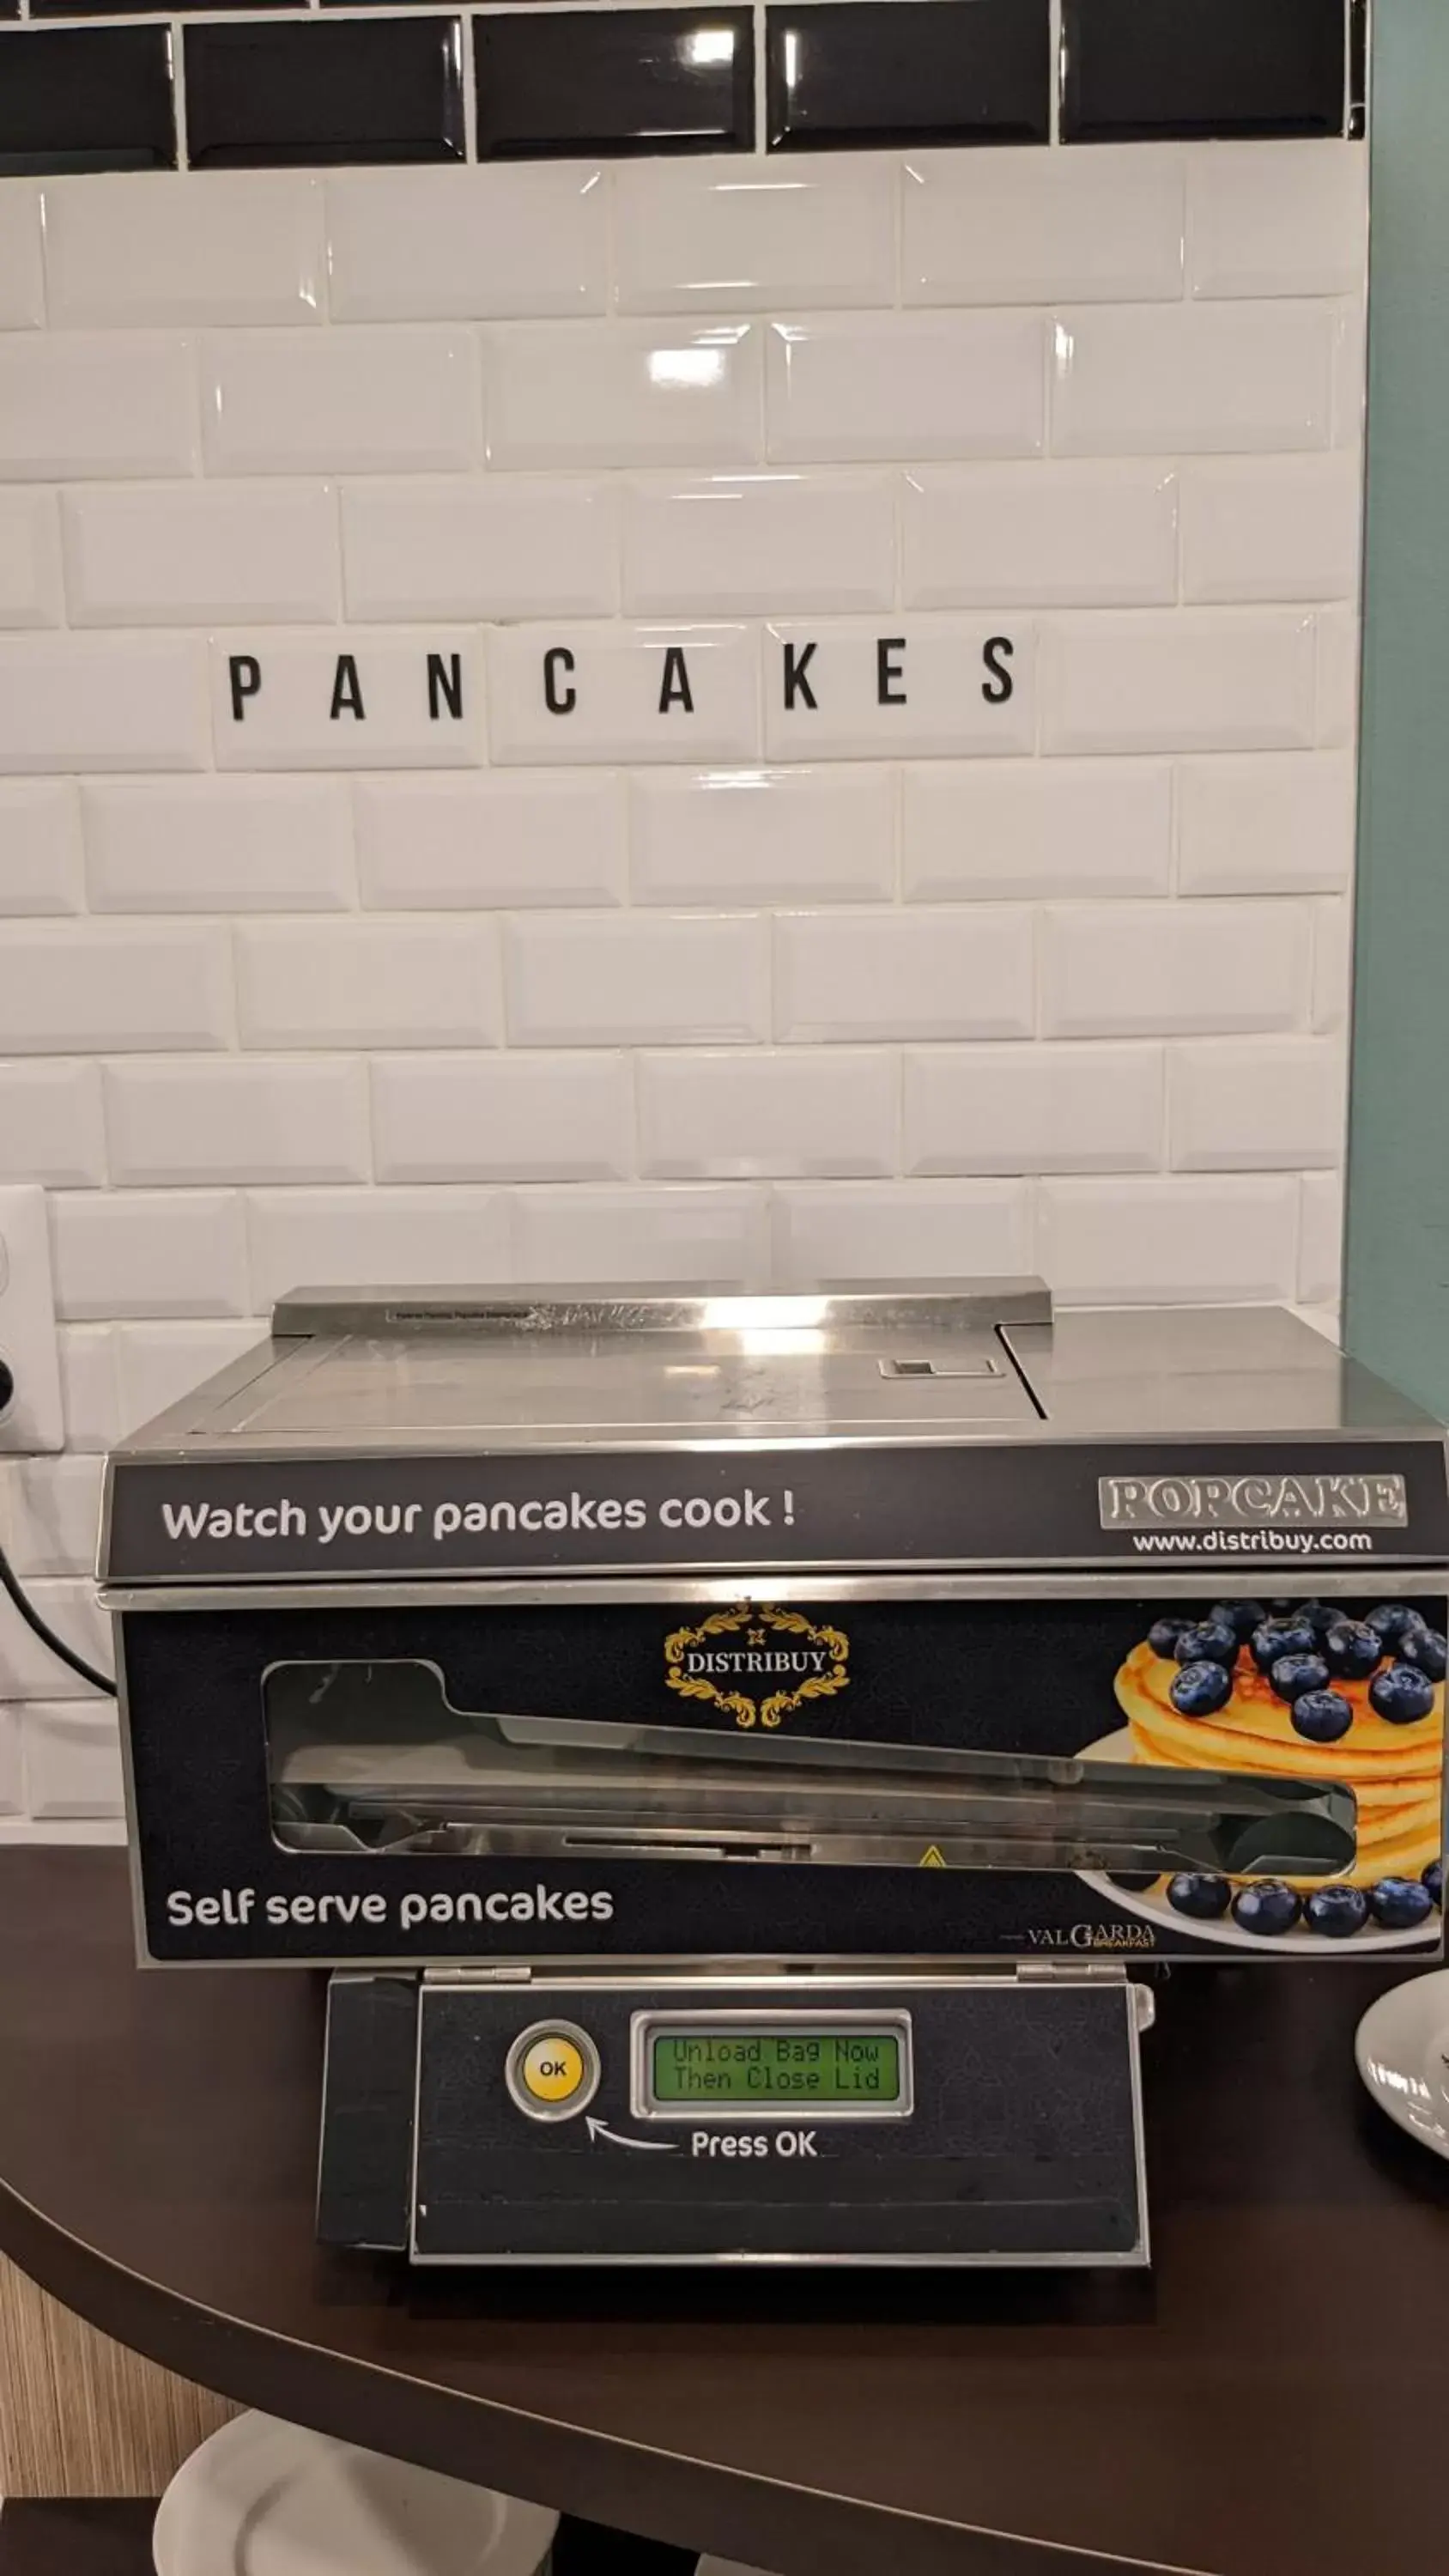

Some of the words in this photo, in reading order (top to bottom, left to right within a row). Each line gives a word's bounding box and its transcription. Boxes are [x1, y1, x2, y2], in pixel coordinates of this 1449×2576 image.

[229, 636, 1015, 720] PANCAKES
[1108, 1475, 1404, 1519] POPCAKE
[162, 1498, 306, 1539] Watch
[318, 1501, 421, 1543] your
[433, 1492, 646, 1540] pancakes
[1133, 1531, 1373, 1553] www.distribuy.com
[687, 1651, 827, 1673] DISTRIBUY
[167, 1889, 255, 1925] Self
[265, 1893, 386, 1924] serve
[401, 1885, 614, 1930] pancakes
[673, 2040, 761, 2063] Unload
[776, 2039, 821, 2063] Bag
[834, 2039, 879, 2063] Now
[539, 2062, 567, 2077] OK
[673, 2067, 732, 2090] Then
[747, 2067, 821, 2089] Close
[835, 2065, 880, 2089] Lid
[692, 2131, 768, 2158] Press
[775, 2130, 818, 2158] OK
